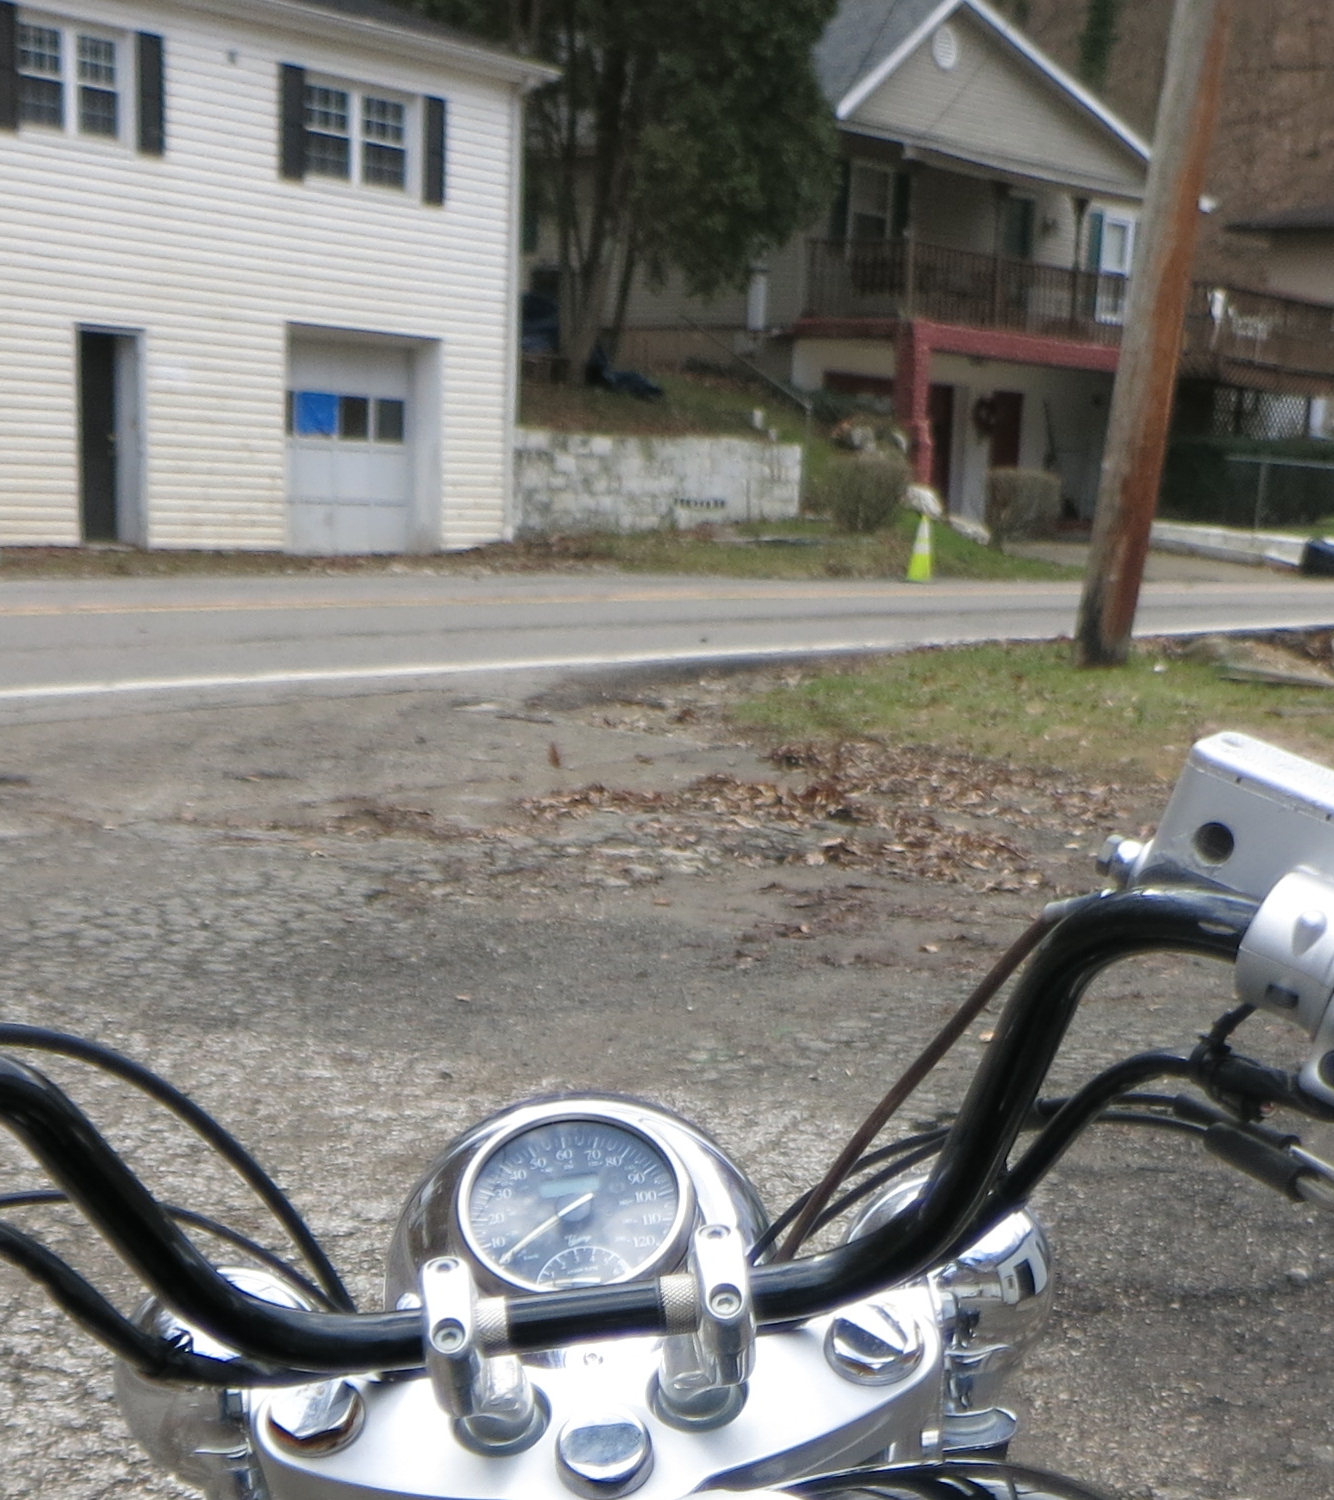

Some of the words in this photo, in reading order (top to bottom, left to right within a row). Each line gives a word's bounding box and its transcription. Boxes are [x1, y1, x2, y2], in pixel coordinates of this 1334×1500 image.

[556, 1149, 573, 1160] 60
[584, 1149, 601, 1160] 70
[530, 1158, 546, 1170] 50
[605, 1157, 622, 1167] 80
[510, 1169, 527, 1181] 40
[628, 1172, 645, 1184] 90
[496, 1188, 512, 1200] 30
[635, 1190, 657, 1203] 100
[488, 1213, 504, 1226] 20
[643, 1213, 661, 1226] 110
[491, 1237, 506, 1249] 10
[633, 1235, 655, 1248] 120
